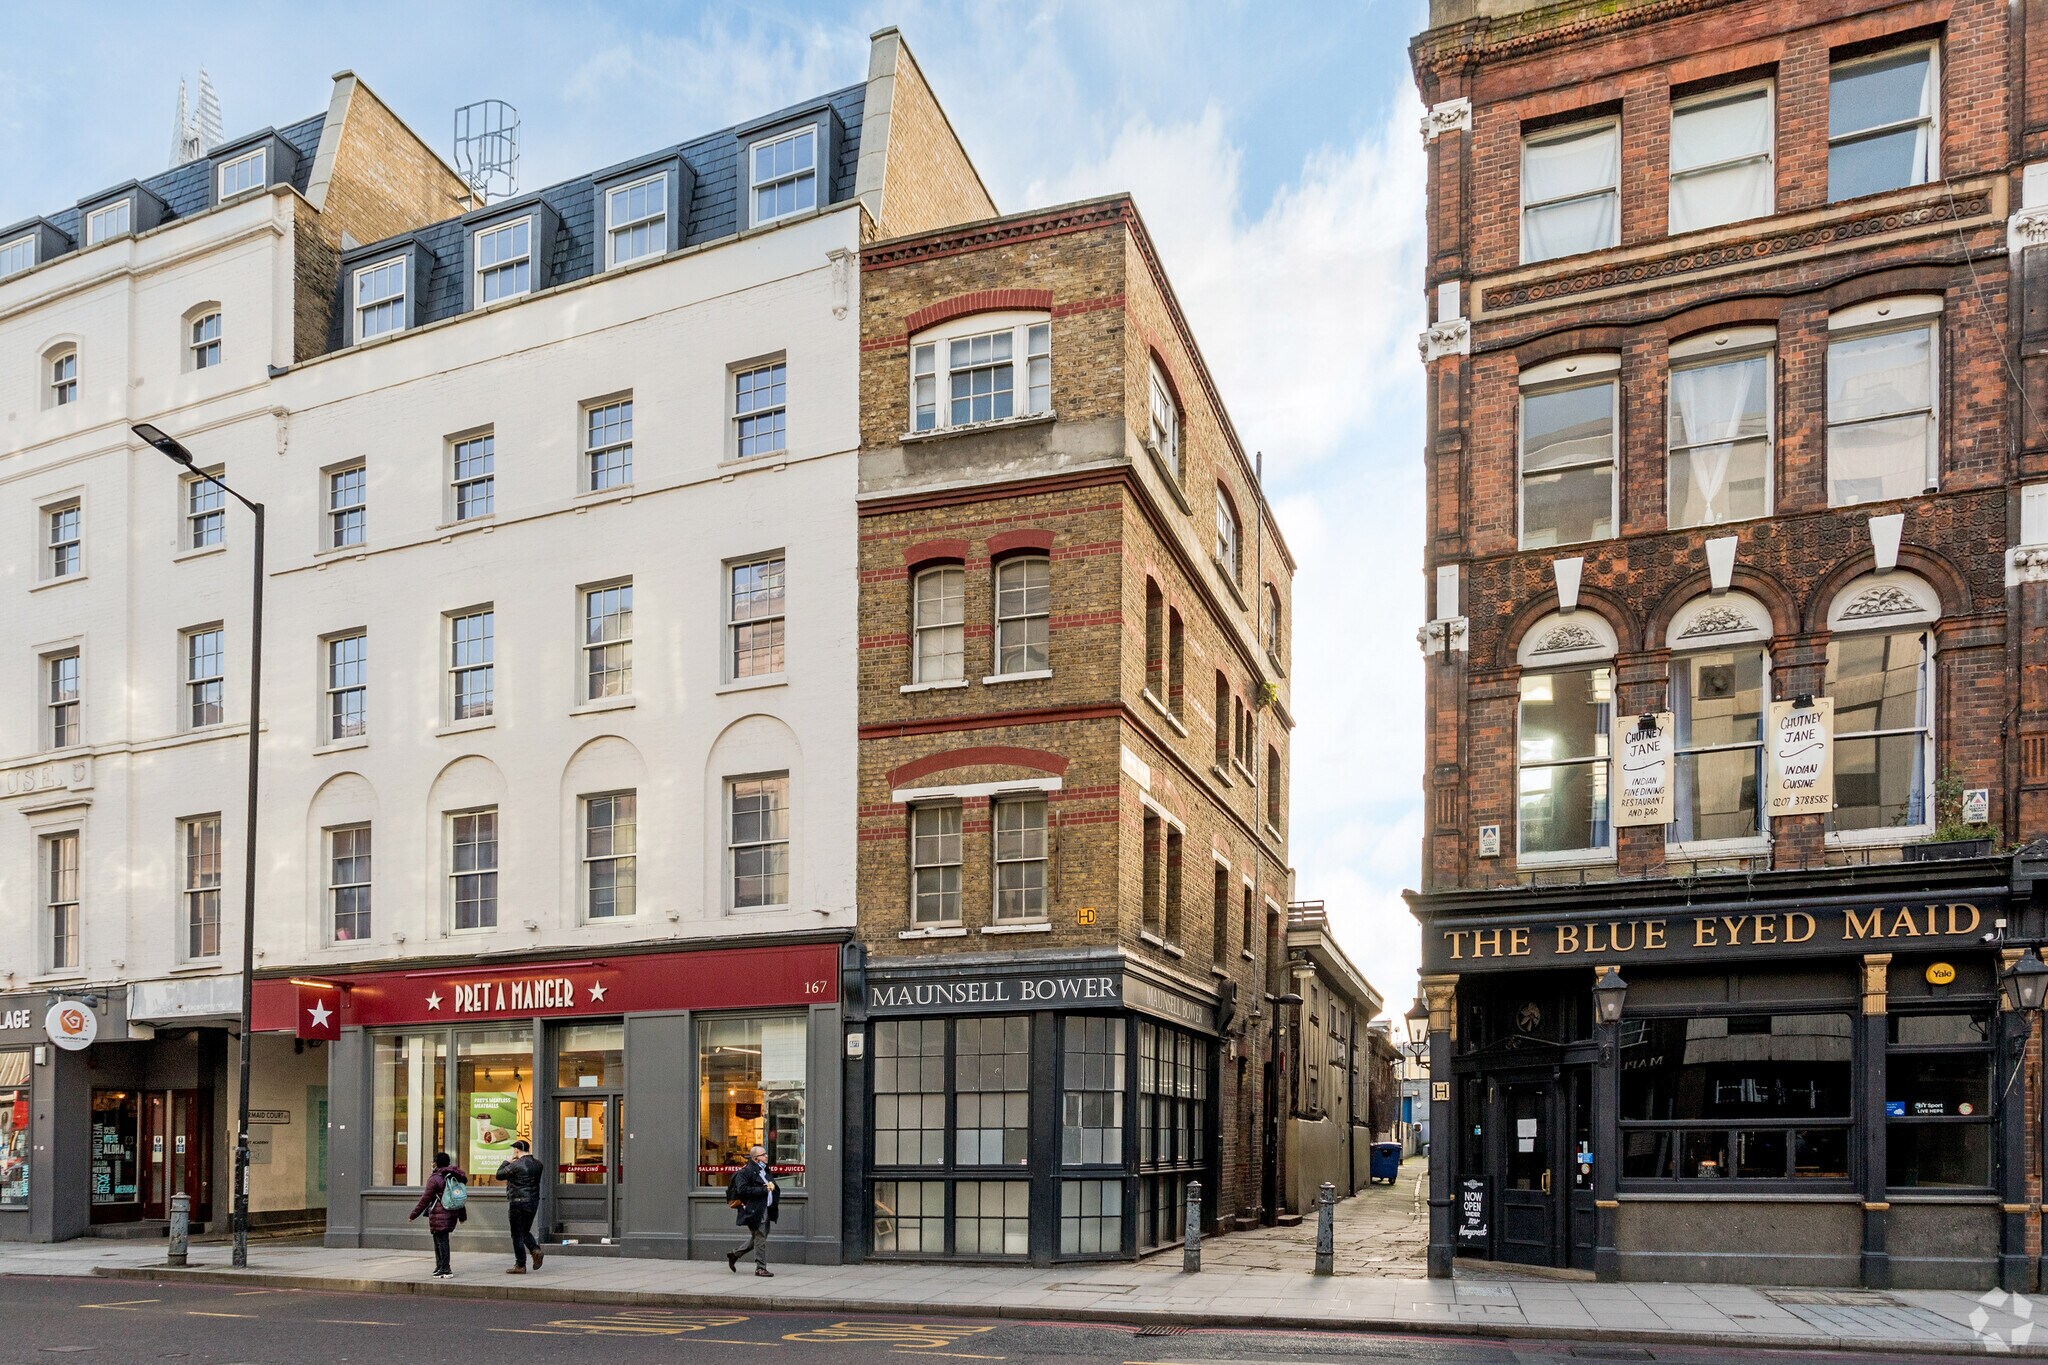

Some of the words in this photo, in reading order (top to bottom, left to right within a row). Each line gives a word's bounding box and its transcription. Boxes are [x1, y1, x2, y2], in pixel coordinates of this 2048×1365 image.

[1780, 711, 1824, 730] CHUTNEY
[1625, 726, 1664, 744] CHUTNEY
[1785, 729, 1816, 743] JANE
[1629, 741, 1661, 757] JANE
[1785, 764, 1818, 775] INDIAN
[1631, 777, 1657, 786] INDIAN
[1782, 778, 1816, 789] CUISINE
[1621, 796, 1665, 807] RESTAURANT
[1795, 794, 1830, 806] 3788585
[1628, 808, 1642, 818] AND
[1644, 807, 1659, 817] BAR
[1443, 927, 1531, 959] THE
[1555, 919, 1667, 954] BLUE
[1692, 911, 1816, 947] EYED
[1842, 903, 1981, 940] MAID
[1933, 970, 1952, 978] Yale
[804, 980, 827, 994] 167
[872, 981, 1010, 1007] MAUNSELL
[1020, 977, 1117, 1001] BOWER
[455, 982, 492, 1013] PRET
[495, 981, 506, 1011] A
[511, 978, 574, 1010] MANGER
[1146, 985, 1181, 1016] MAUNSELL
[1182, 1001, 1203, 1024] BOWER
[93, 1123, 103, 1159] WELCOME
[103, 1144, 124, 1155] ALOHA
[1464, 1191, 1483, 1201] NOW
[1463, 1201, 1482, 1211] OPEN
[782, 1321, 998, 1348] BUS
